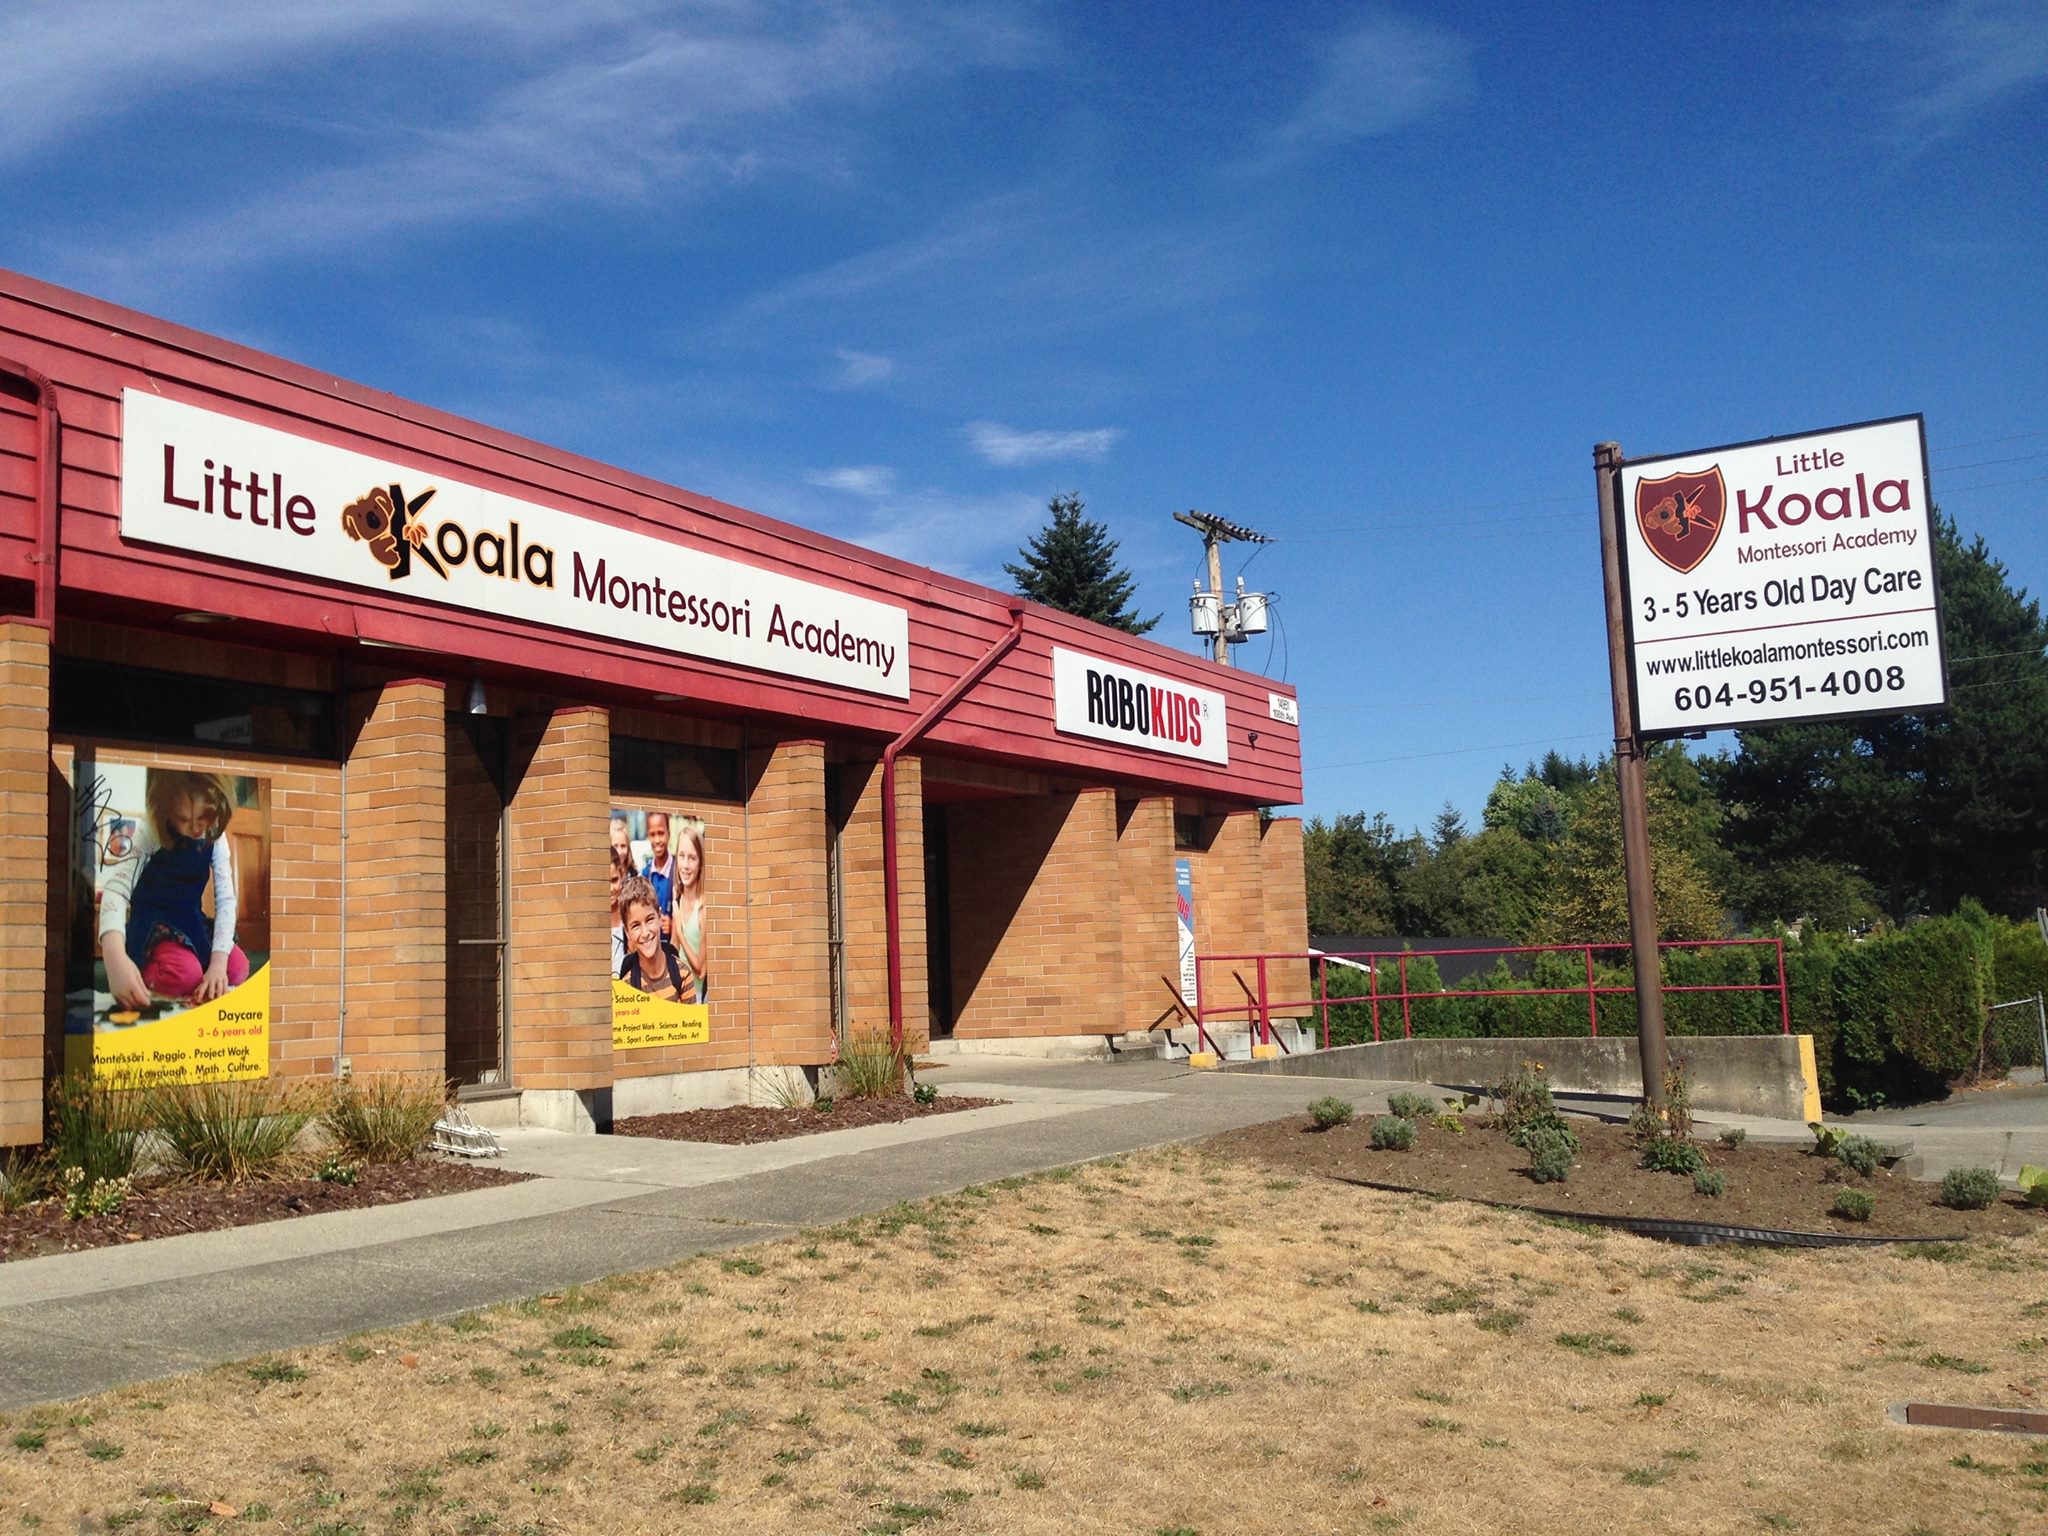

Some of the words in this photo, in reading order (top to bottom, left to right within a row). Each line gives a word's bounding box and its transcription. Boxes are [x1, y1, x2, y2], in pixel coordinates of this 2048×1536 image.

[1776, 448, 1845, 476] Little
[1736, 473, 1911, 534] Koala
[1737, 536, 1826, 564] Montessori
[1832, 528, 1917, 551] Academy
[163, 444, 316, 536] Little
[388, 482, 555, 590] Koala
[573, 551, 750, 638] Montessori
[767, 604, 895, 678] Academy
[1643, 596, 1657, 622] 3
[1676, 592, 1689, 618] 5
[1693, 588, 1758, 615] Years
[1763, 577, 1805, 607] Old
[1811, 574, 1857, 606] Day
[1864, 567, 1922, 595] Care
[1646, 630, 1929, 676] www.littlekoalamontessori.com
[1674, 665, 1905, 711] 604-951-4008
[1086, 669, 1202, 747] ROBOKIDS
[615, 994, 635, 1004] School
[636, 993, 650, 1002] Care
[218, 1009, 263, 1023] Daycare
[615, 1010, 630, 1018] years
[631, 1008, 640, 1016] old
[222, 1028, 246, 1039] years
[248, 1025, 263, 1035] old
[622, 1024, 641, 1034] Project
[642, 1022, 655, 1031] Work
[659, 1021, 678, 1030] Science
[682, 1019, 702, 1030] Reading
[627, 1035, 642, 1045] Sport
[645, 1034, 664, 1043] Games
[668, 1032, 687, 1041] Puzzles
[691, 1031, 699, 1039] Art
[92, 1051, 145, 1065] Montessori
[153, 1049, 186, 1063] Reggio
[194, 1047, 225, 1060] Project
[227, 1045, 250, 1056] Work
[195, 1063, 220, 1075] Math
